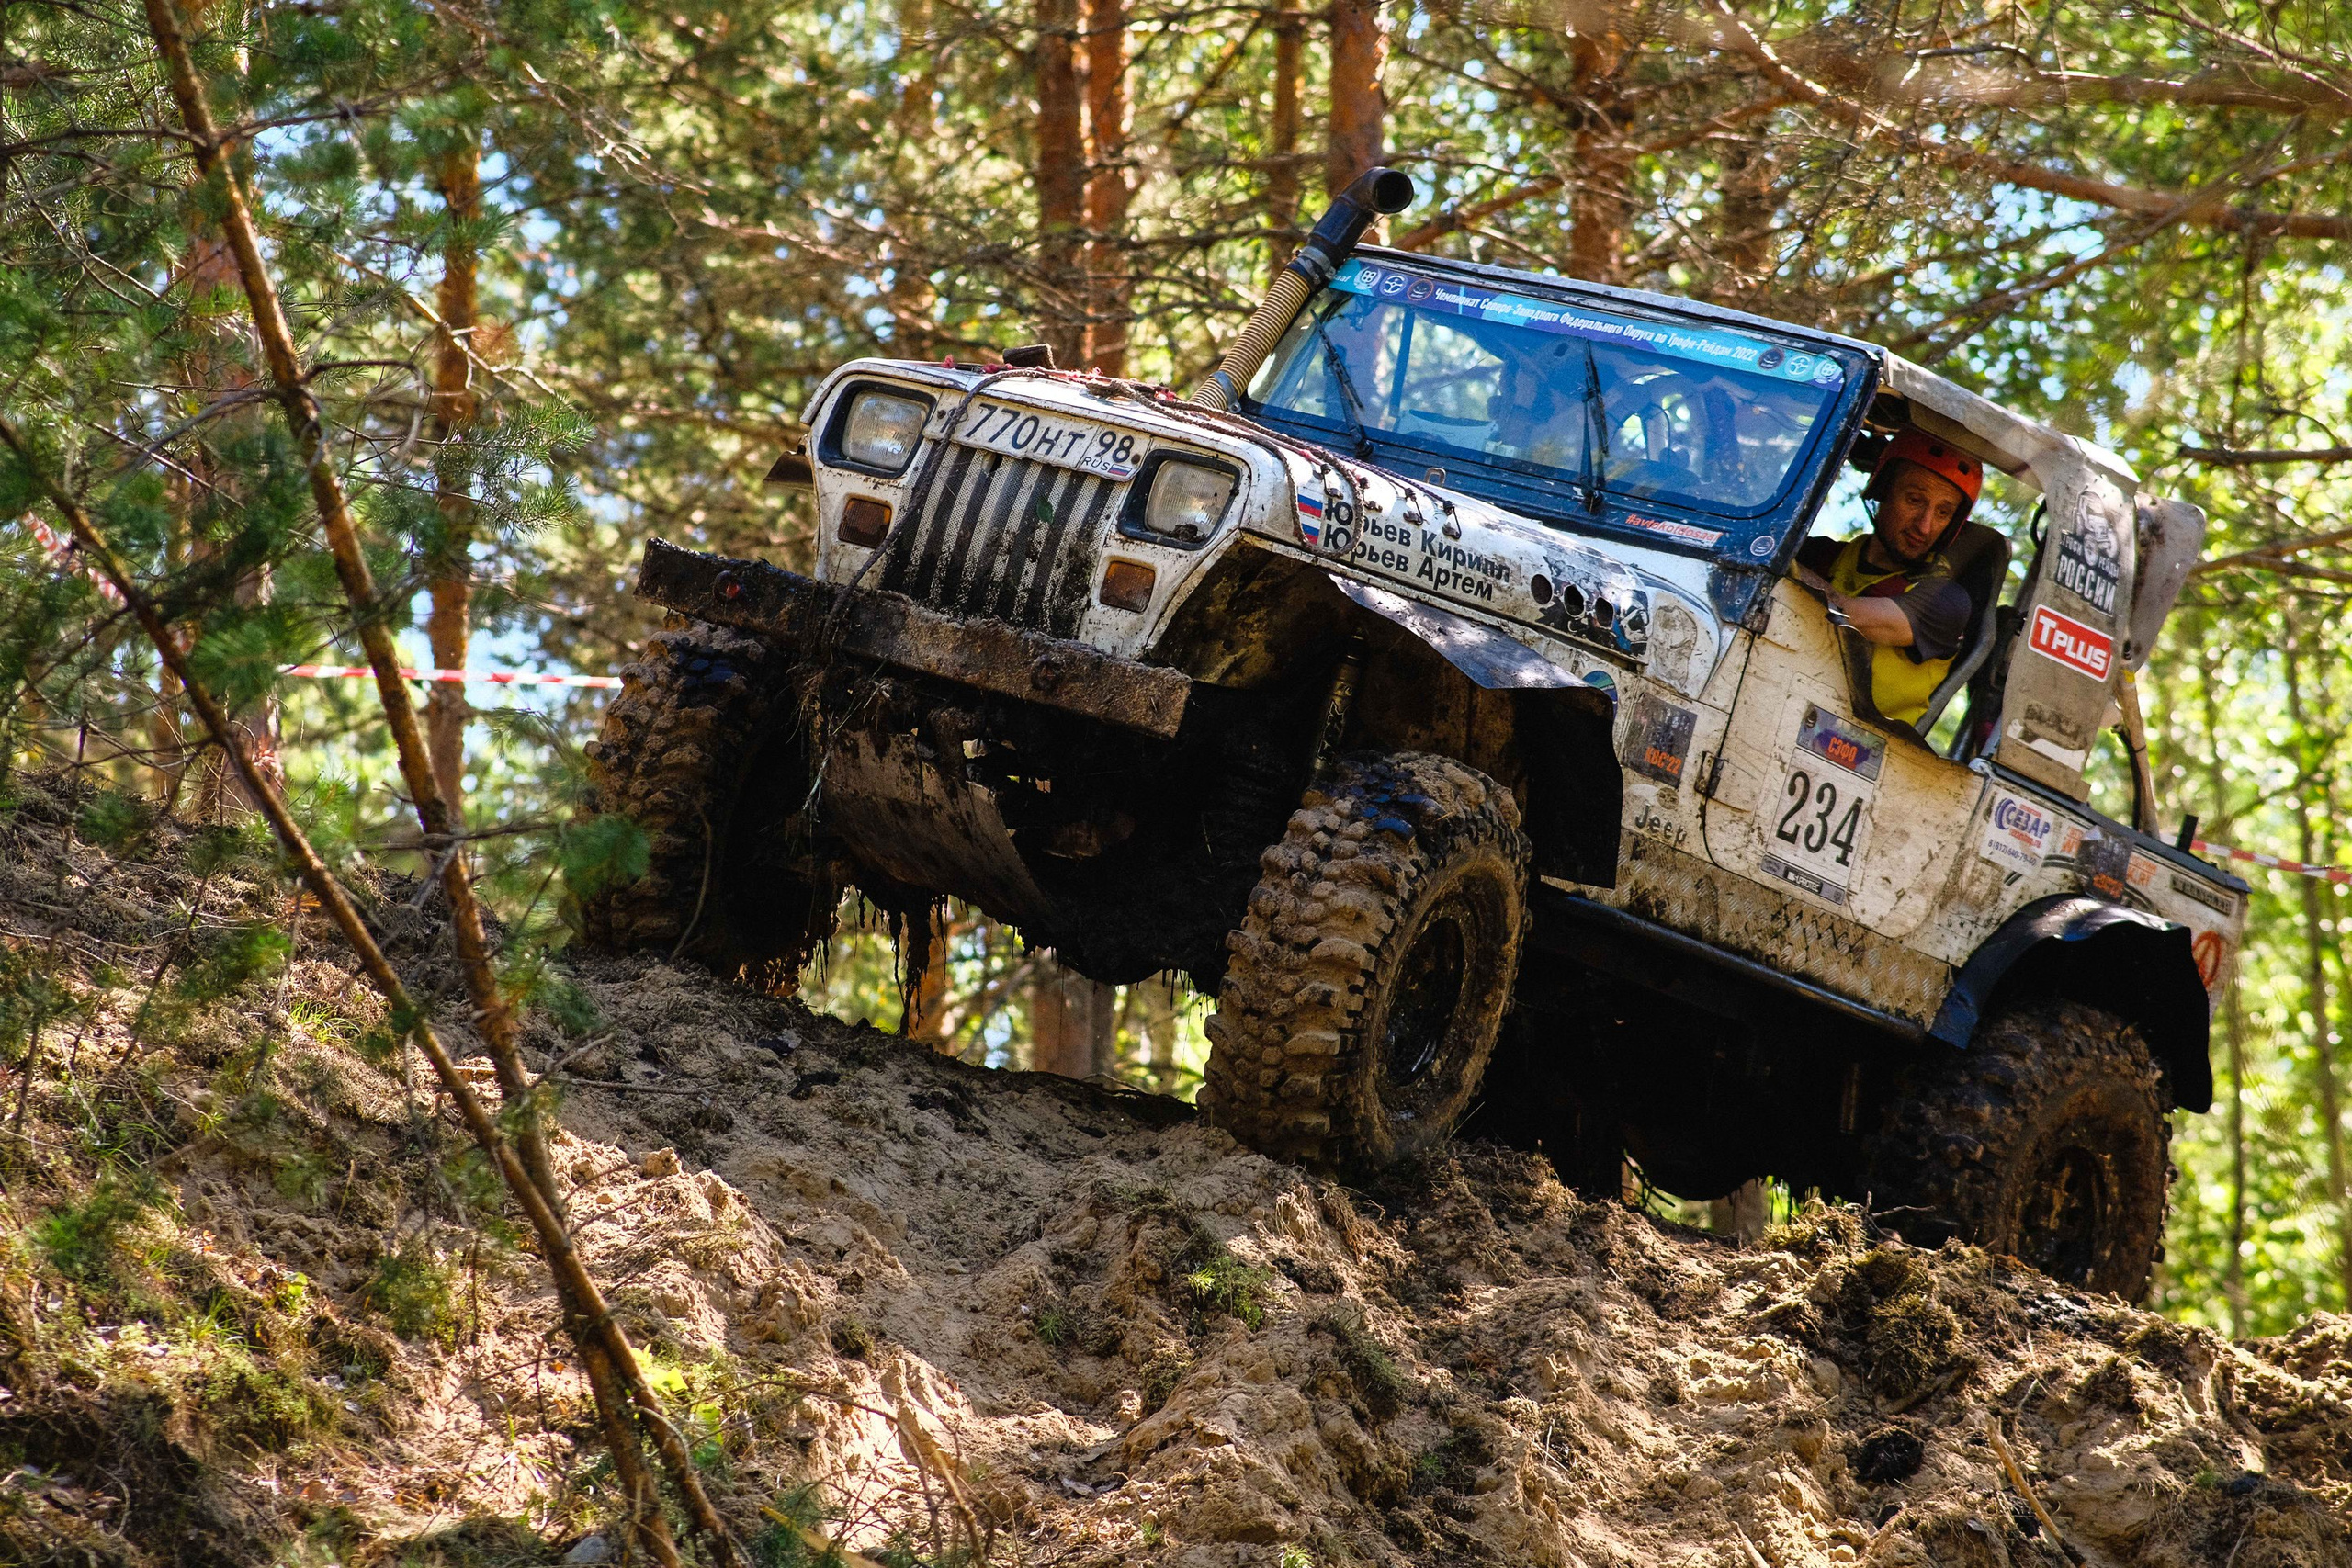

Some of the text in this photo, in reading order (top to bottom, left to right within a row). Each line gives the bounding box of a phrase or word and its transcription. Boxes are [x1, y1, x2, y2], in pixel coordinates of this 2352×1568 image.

[1435, 288, 1758, 361] Чемпионат Северо-Западного Федерального Округа по Трофи-Рейдам 2022
[1081, 456, 1109, 471] RUS
[1098, 431, 1135, 463] 98
[1416, 558, 1493, 601] Артем
[2057, 555, 2116, 613] РОССИИ
[1827, 736, 1859, 762] СЗФО
[1634, 804, 1687, 846] Jeep
[1775, 770, 1864, 867] 234
